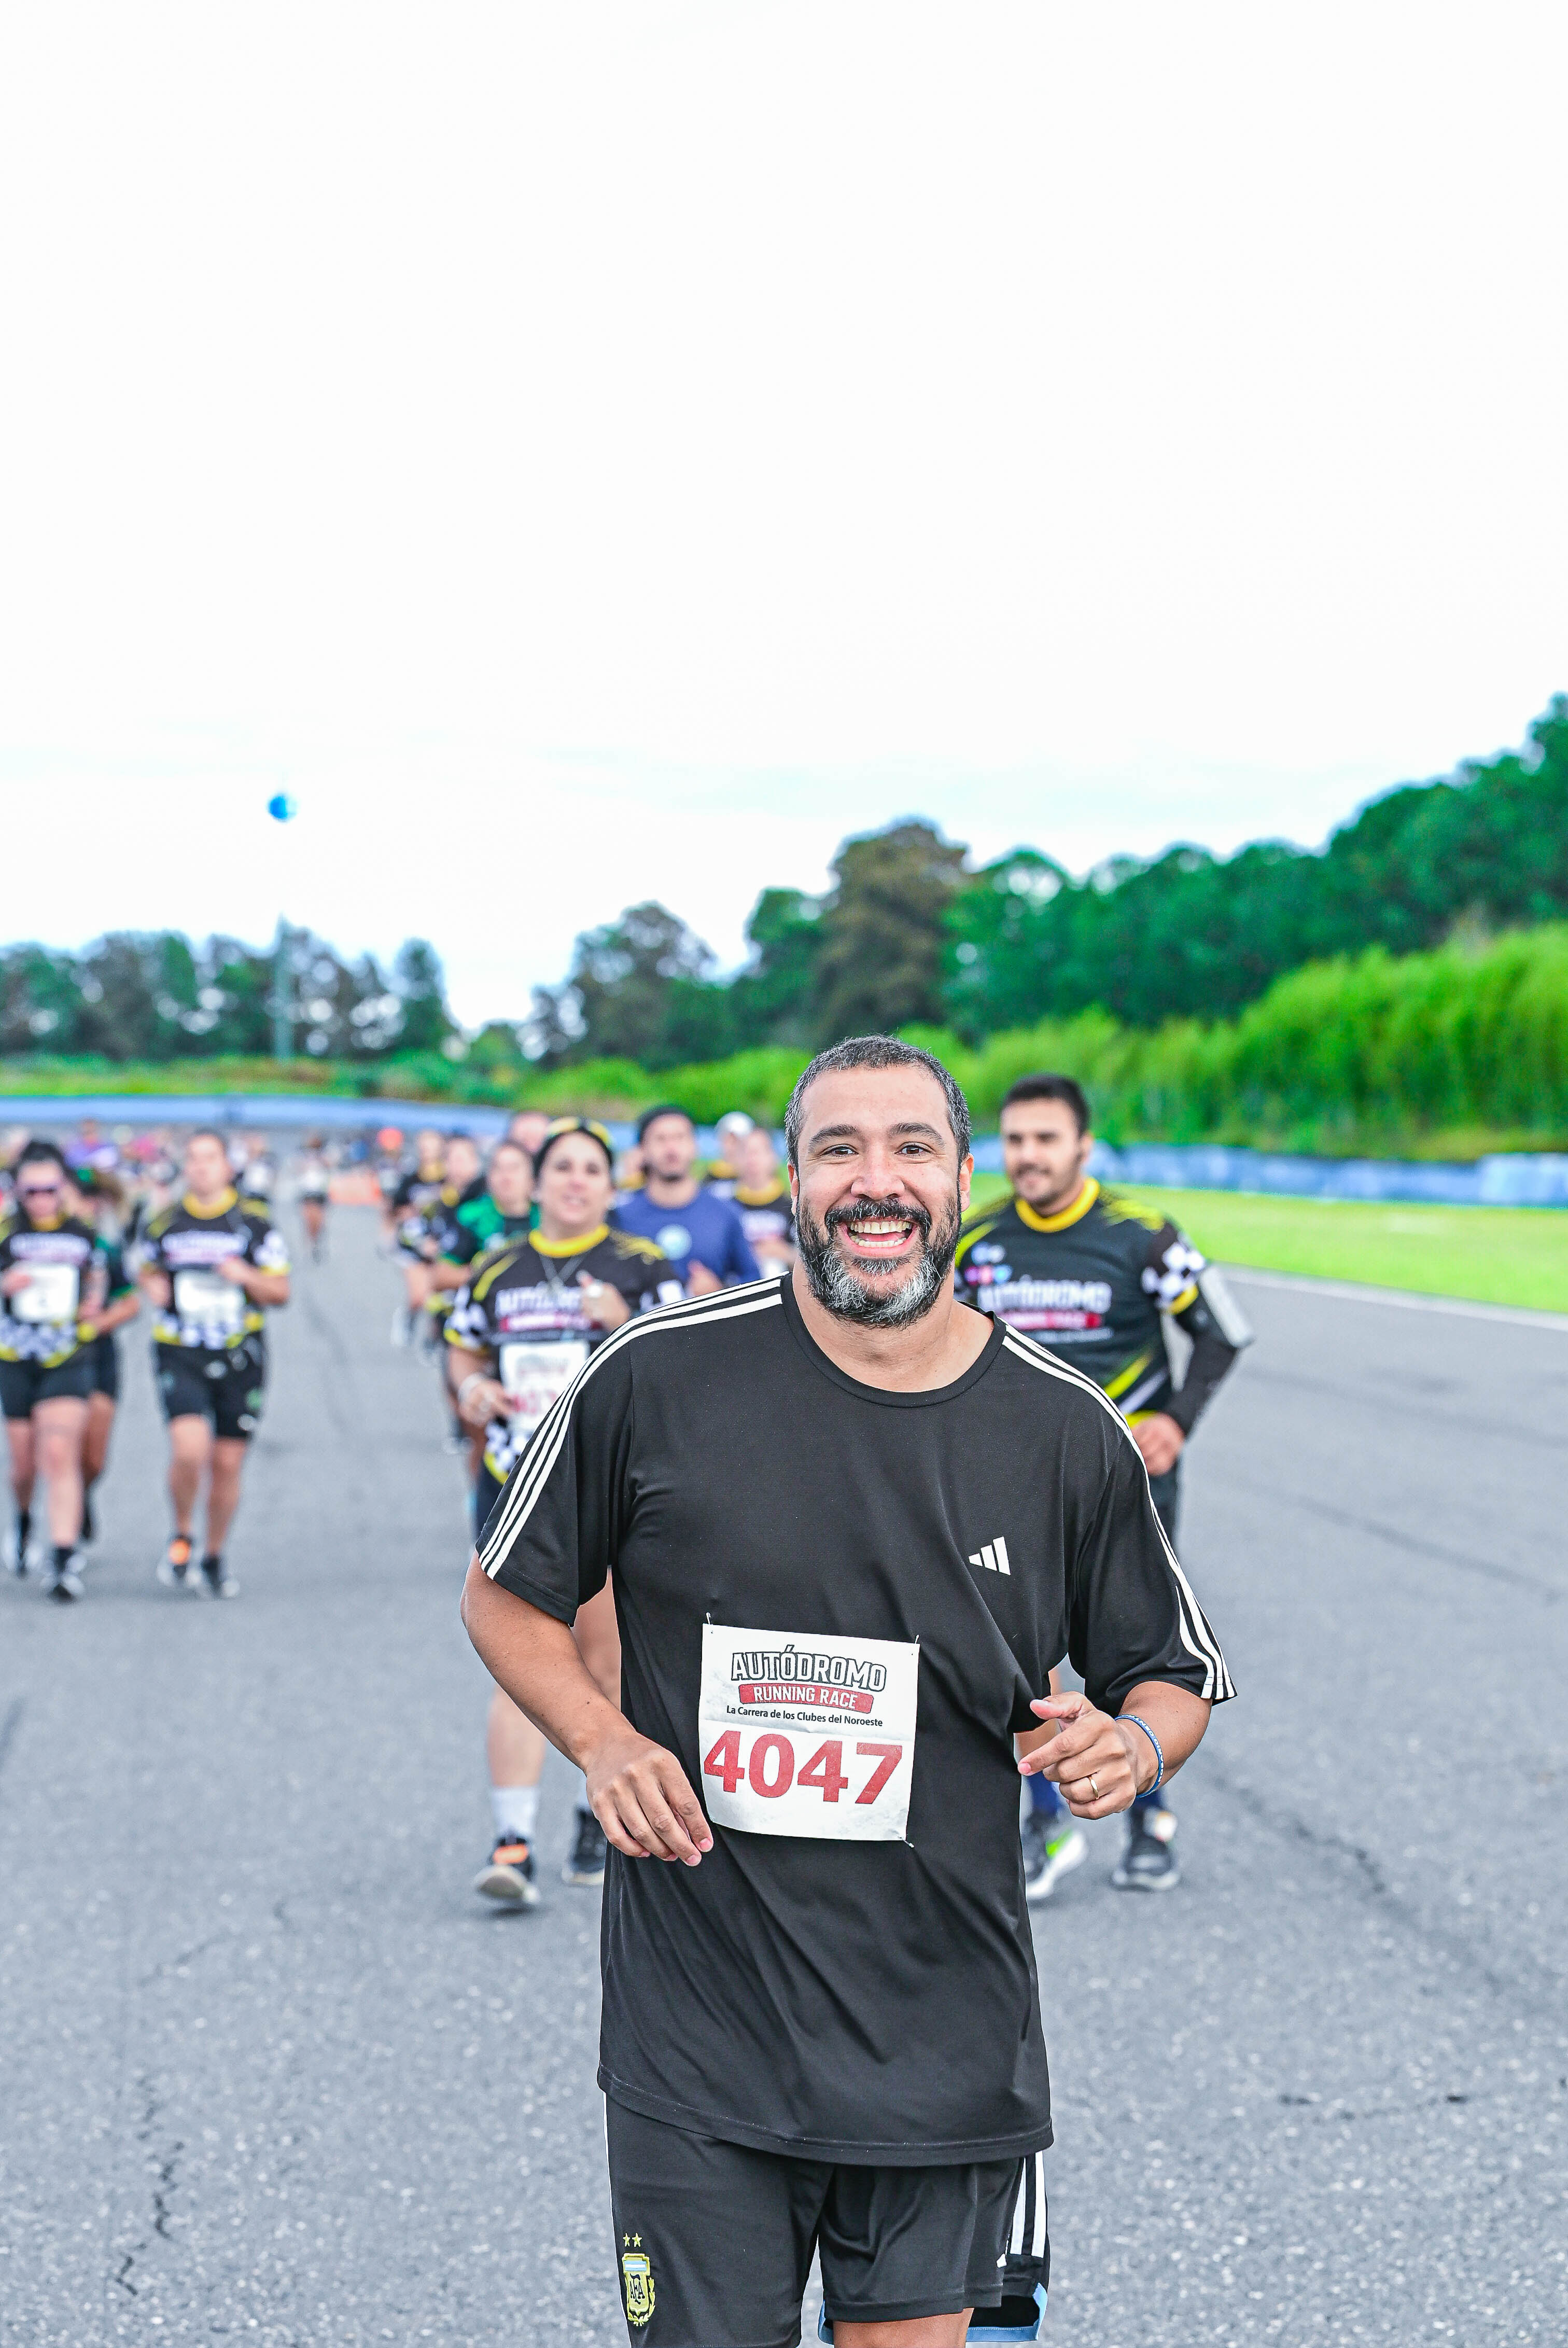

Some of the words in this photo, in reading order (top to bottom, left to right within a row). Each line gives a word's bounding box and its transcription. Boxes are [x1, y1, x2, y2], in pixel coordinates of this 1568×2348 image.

[731, 1644, 887, 1693] AUTÓDROMO
[726, 1705, 736, 1714] La
[737, 1707, 768, 1717] Carrera
[770, 1709, 781, 1718] de
[783, 1710, 795, 1720] los
[797, 1712, 826, 1723] Clubes
[828, 1714, 842, 1724] del
[844, 1715, 883, 1727] Noroeste
[753, 1685, 816, 1702] RUNNING
[819, 1688, 858, 1710] RACE
[703, 1730, 903, 1805] 4047
